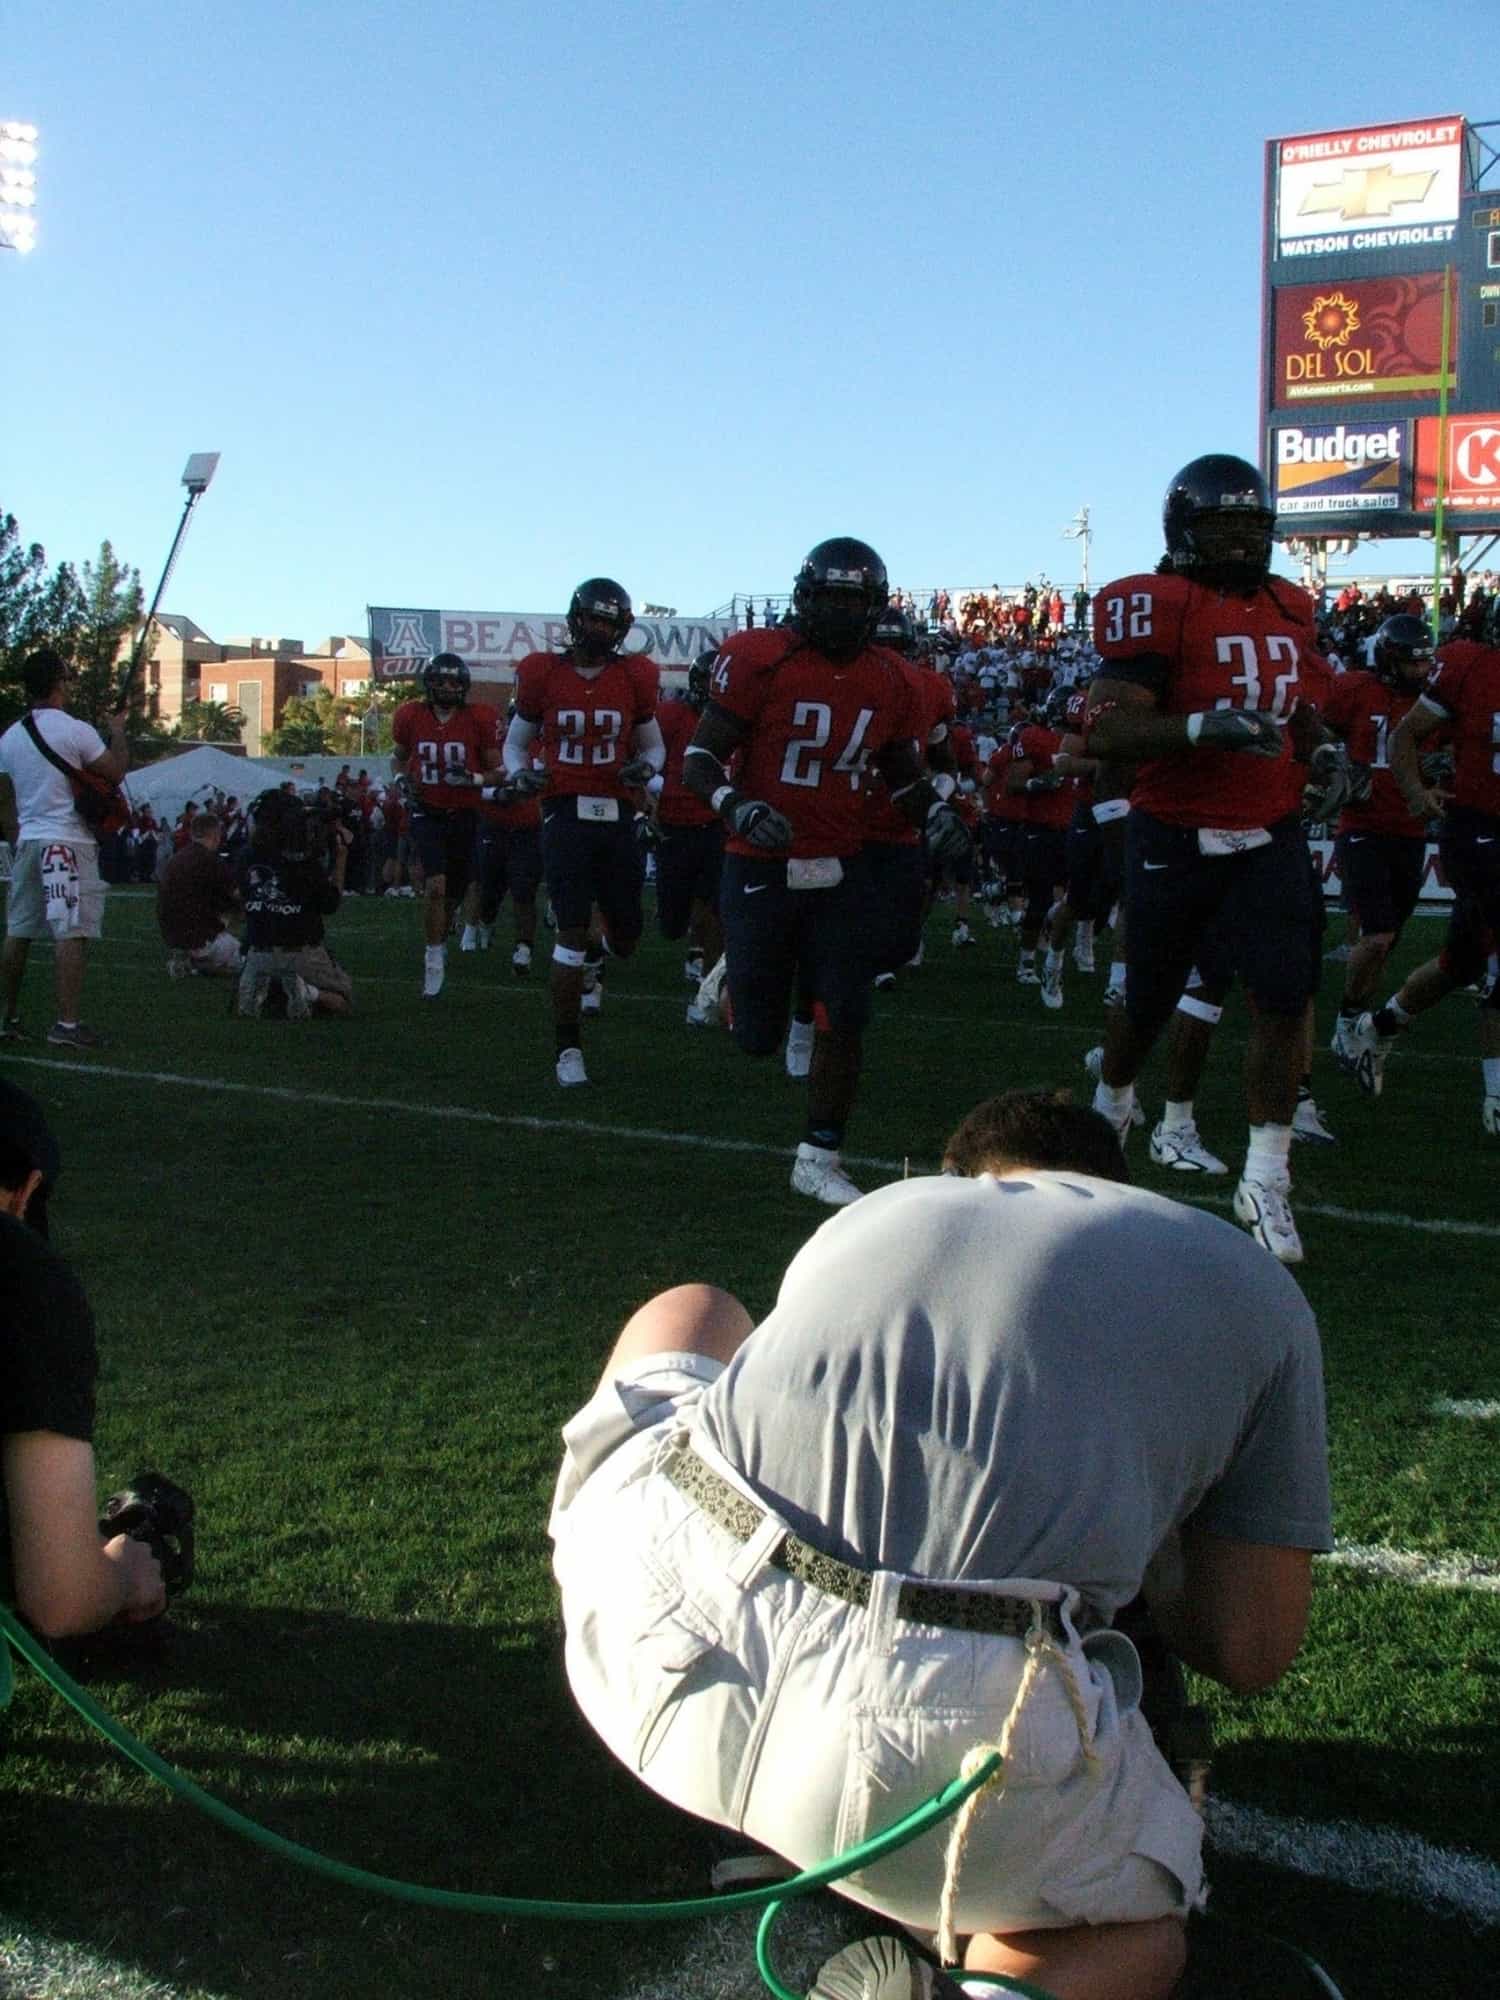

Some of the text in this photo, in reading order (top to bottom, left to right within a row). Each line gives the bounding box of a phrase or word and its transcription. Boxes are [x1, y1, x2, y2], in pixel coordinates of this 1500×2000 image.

[1282, 126, 1457, 161] O'RIELLY CHEVROLET
[1280, 225, 1456, 257] WATSON CHEVROLET
[1286, 349, 1375, 380] DEL SOL
[1278, 426, 1401, 470] Budget
[1279, 495, 1396, 512] car and truck sales
[1106, 593, 1153, 641] 32
[619, 623, 730, 657] OWN
[1215, 635, 1299, 725] 32
[557, 708, 623, 766] 23
[780, 701, 875, 791] 24
